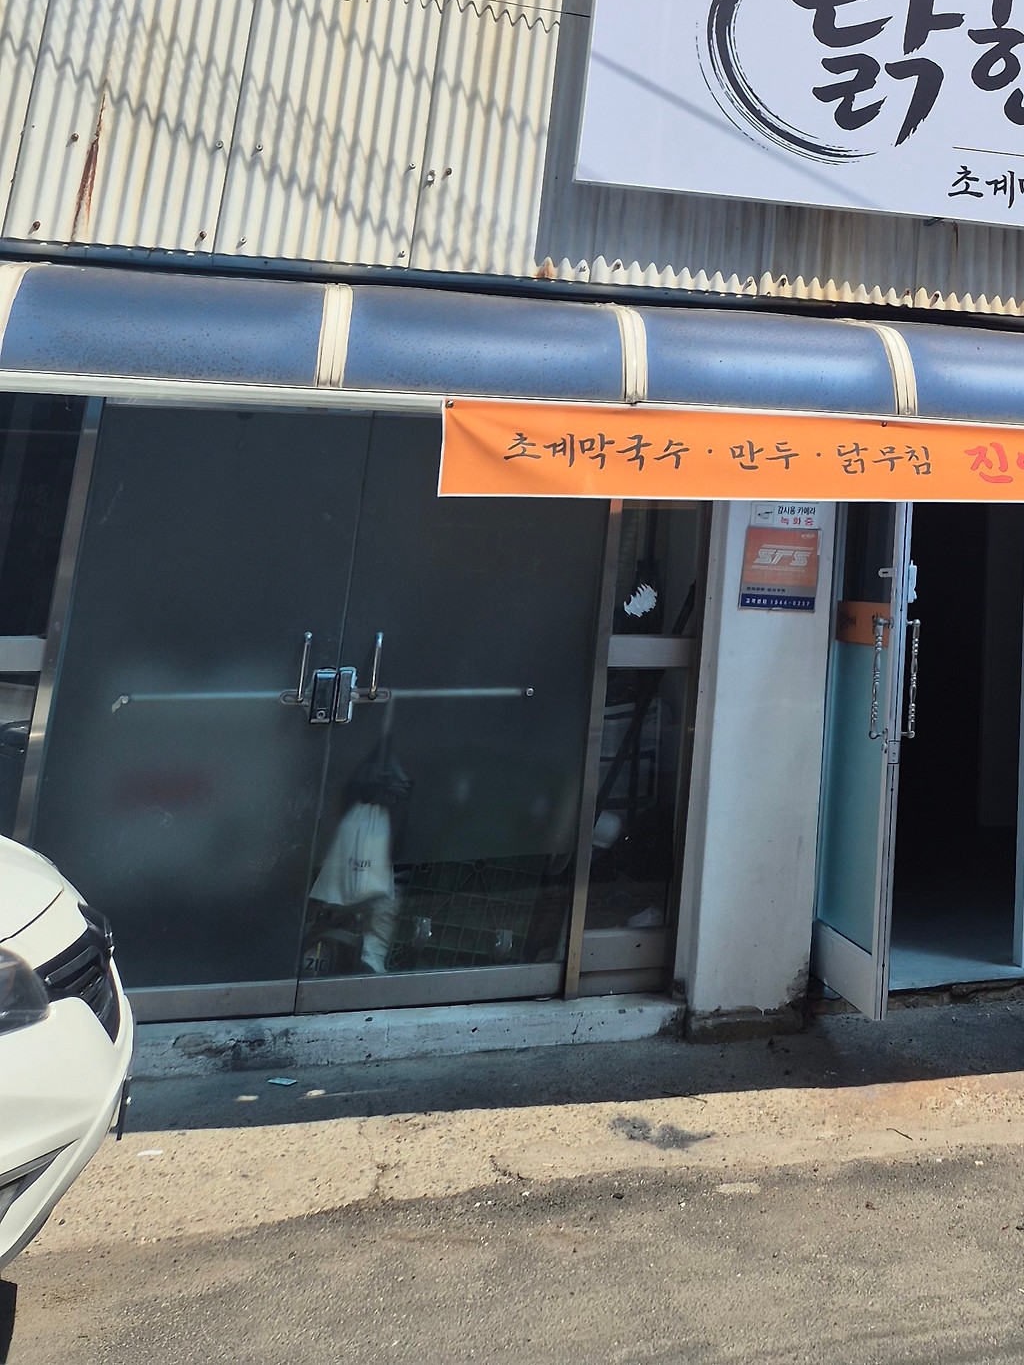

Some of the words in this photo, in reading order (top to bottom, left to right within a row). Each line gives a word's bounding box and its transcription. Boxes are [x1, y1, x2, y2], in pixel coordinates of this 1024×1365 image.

[503, 432, 690, 472] 초계막국수
[729, 440, 800, 471] 만두
[836, 442, 932, 476] 닭무침
[778, 506, 796, 515] 감시용
[797, 507, 816, 516] 카메라
